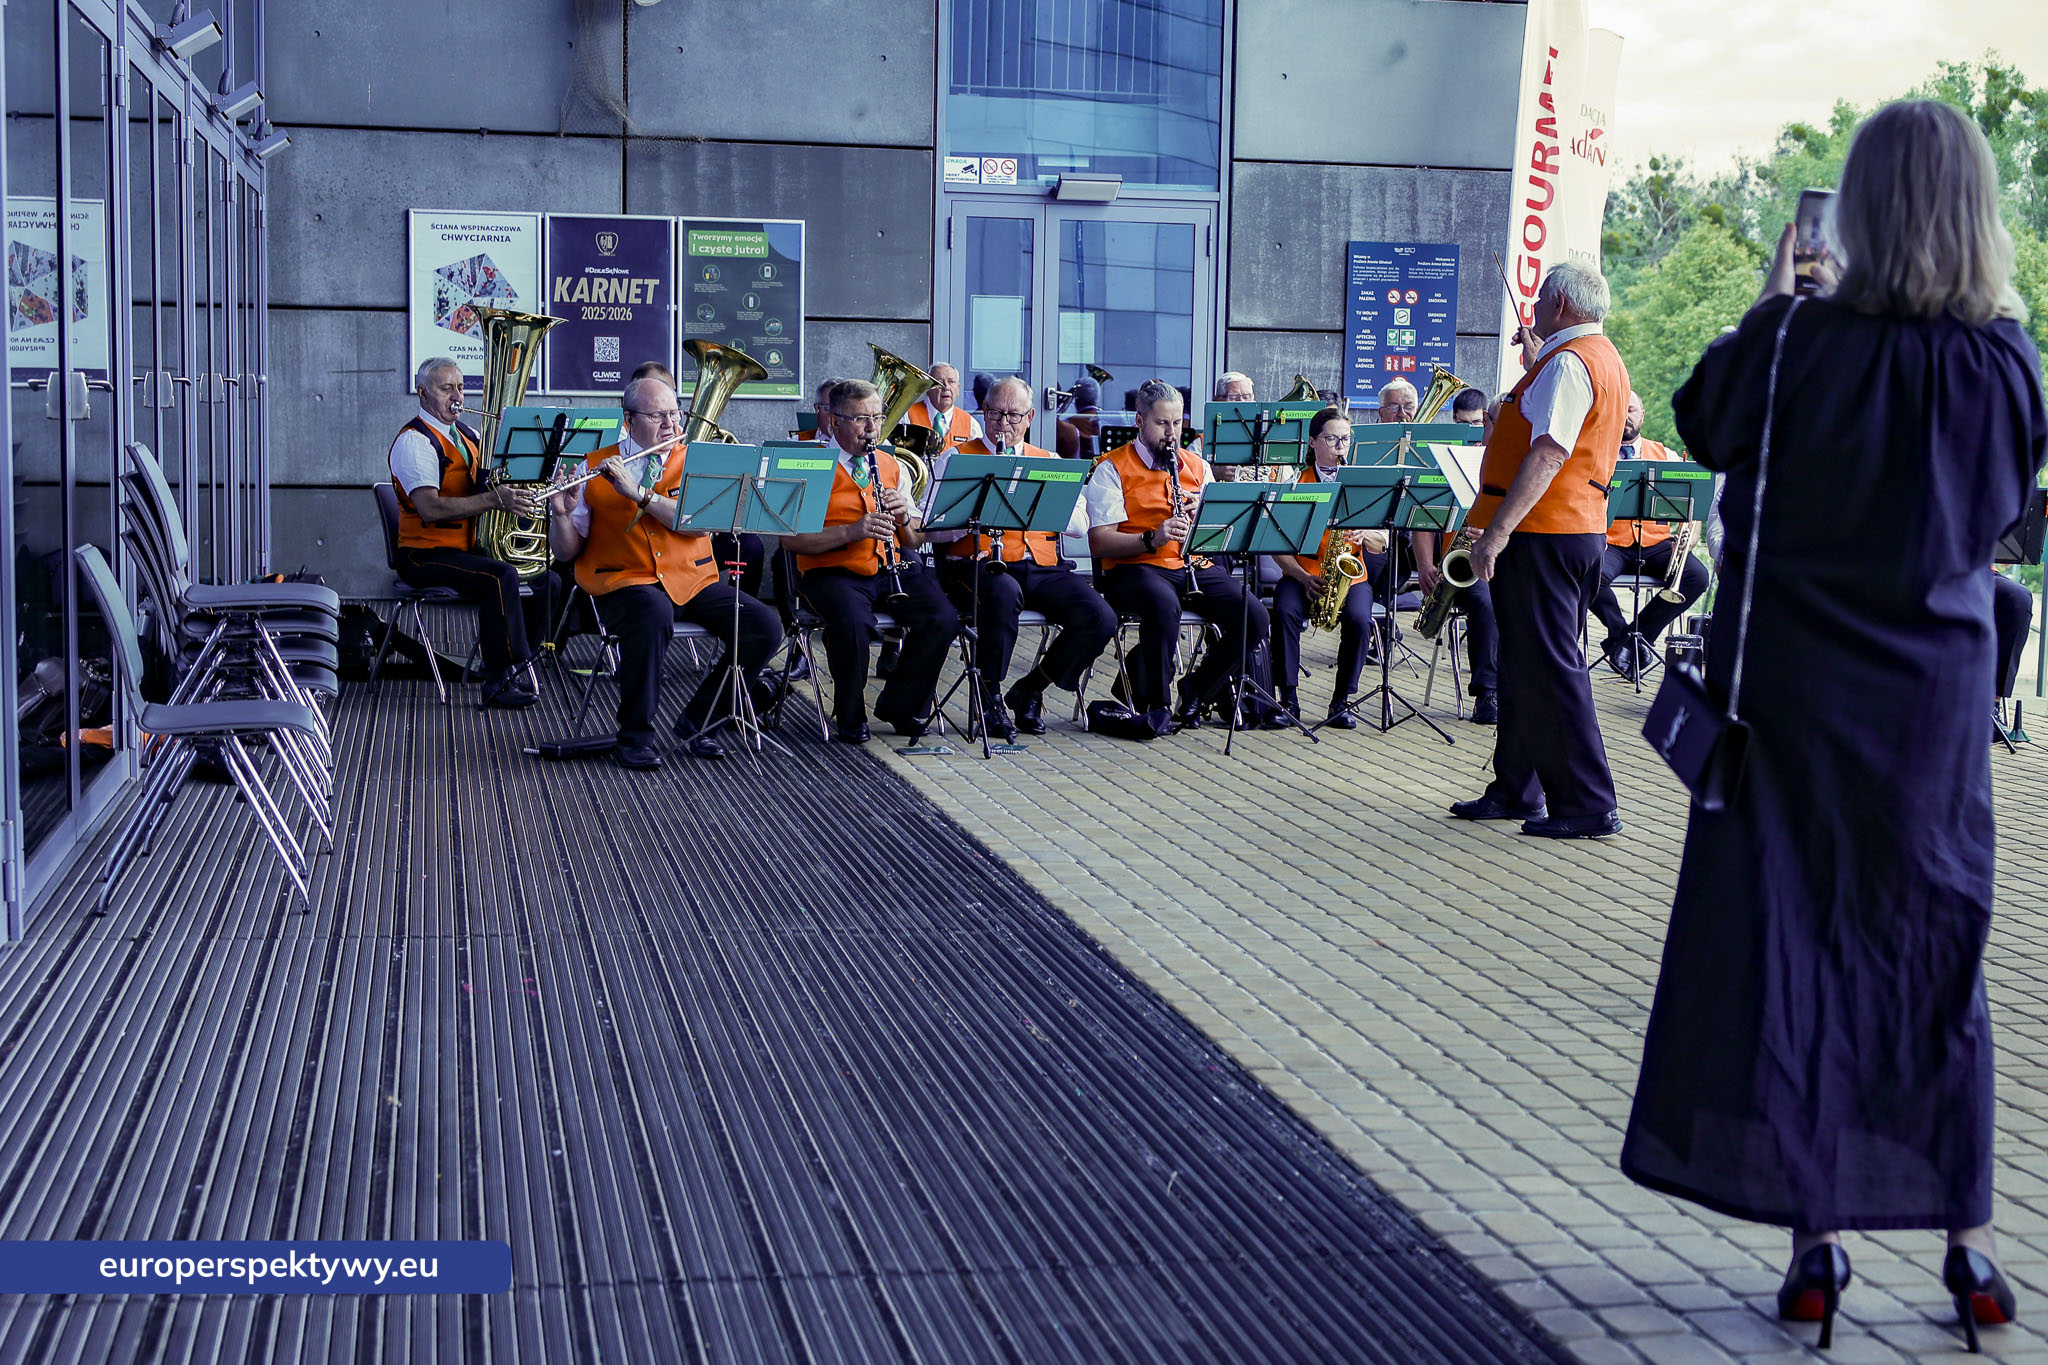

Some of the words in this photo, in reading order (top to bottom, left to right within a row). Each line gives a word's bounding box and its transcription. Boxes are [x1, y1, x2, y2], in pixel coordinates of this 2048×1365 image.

[430, 222, 459, 230] ŚCIANA
[460, 224, 521, 232] WSPINACZKOWA
[441, 233, 511, 243] CHWYCIARNIA
[692, 233, 733, 242] Tworzymy
[734, 234, 763, 243] emocje
[698, 245, 733, 255] czyste
[734, 245, 765, 256] jutro!
[553, 276, 660, 305] KARNET
[581, 306, 633, 321] 2025/2026
[592, 371, 621, 379] GLIWICE
